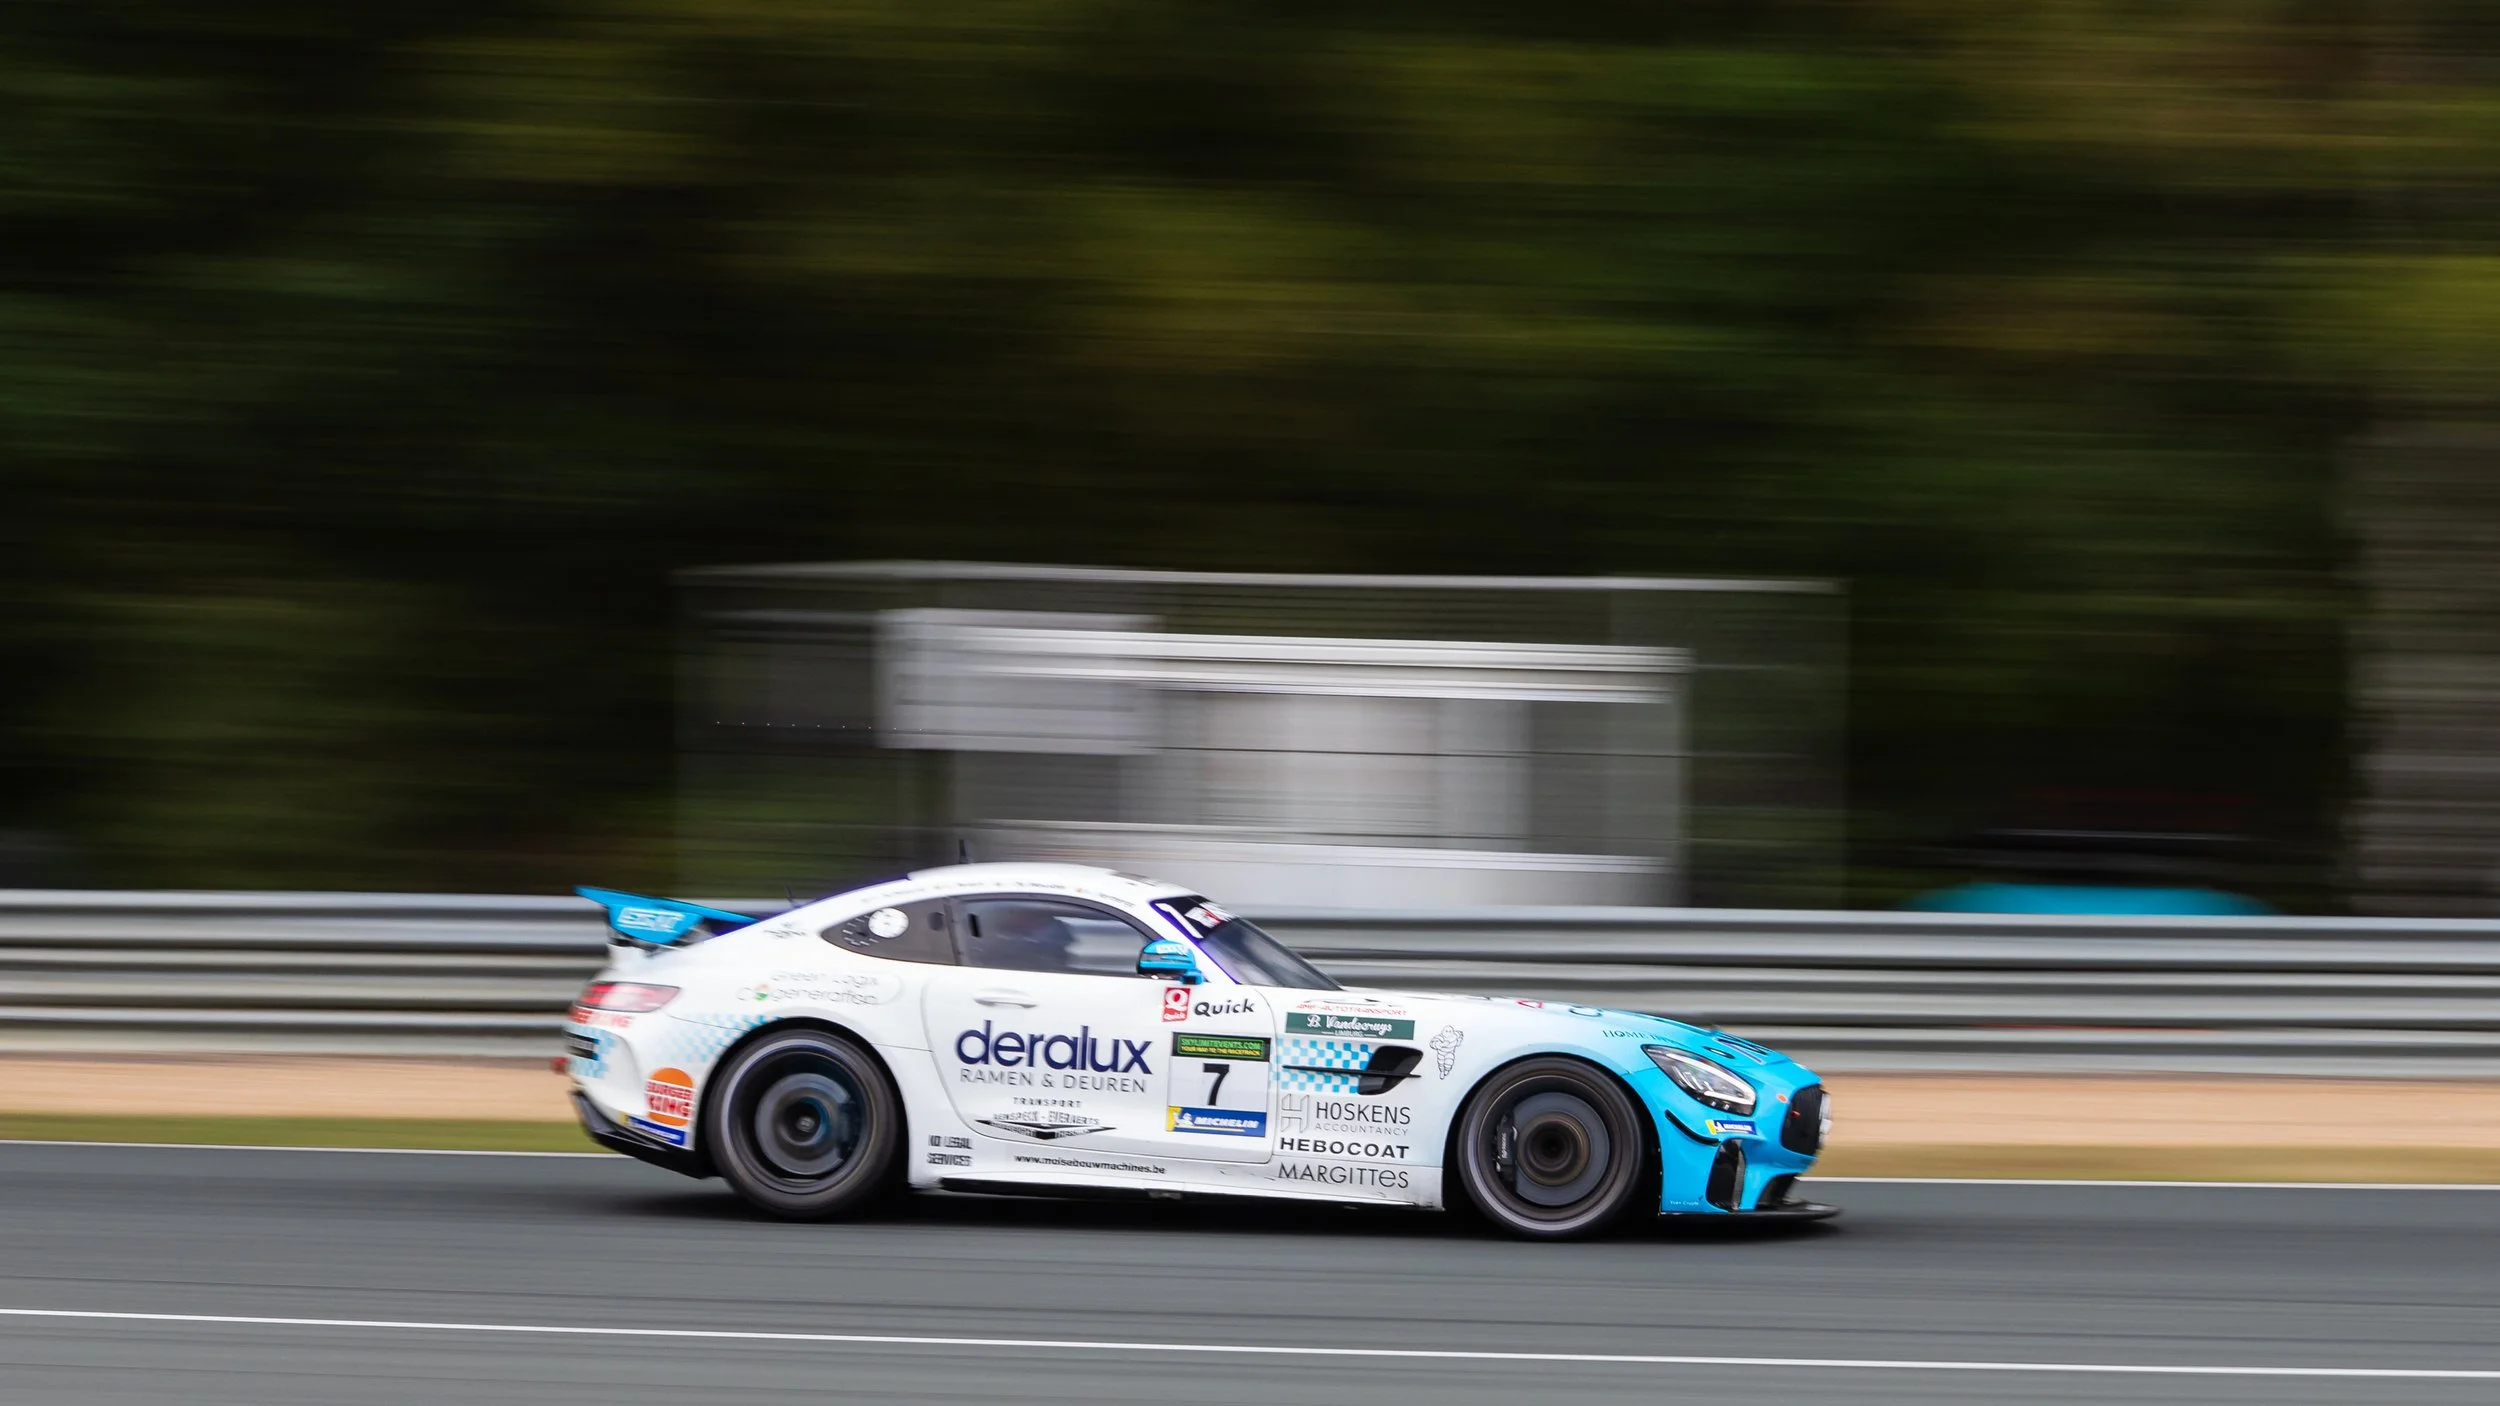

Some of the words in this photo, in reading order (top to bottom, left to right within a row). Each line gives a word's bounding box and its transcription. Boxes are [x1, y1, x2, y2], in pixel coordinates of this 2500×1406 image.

[1193, 998, 1255, 1017] Quick
[956, 1019, 1153, 1075] deralux
[959, 1068, 1033, 1087] RAMEN
[1041, 1073, 1054, 1088] &
[1064, 1075, 1147, 1093] DEUREN
[1202, 1062, 1230, 1107] 7
[1013, 1097, 1083, 1109] TRANSPORT
[1315, 1101, 1412, 1125] HOSKENS
[1193, 1116, 1260, 1129] MICHELIN
[1314, 1122, 1409, 1136] ACCOUNTANCY
[1280, 1137, 1410, 1159] HEBOCOAT
